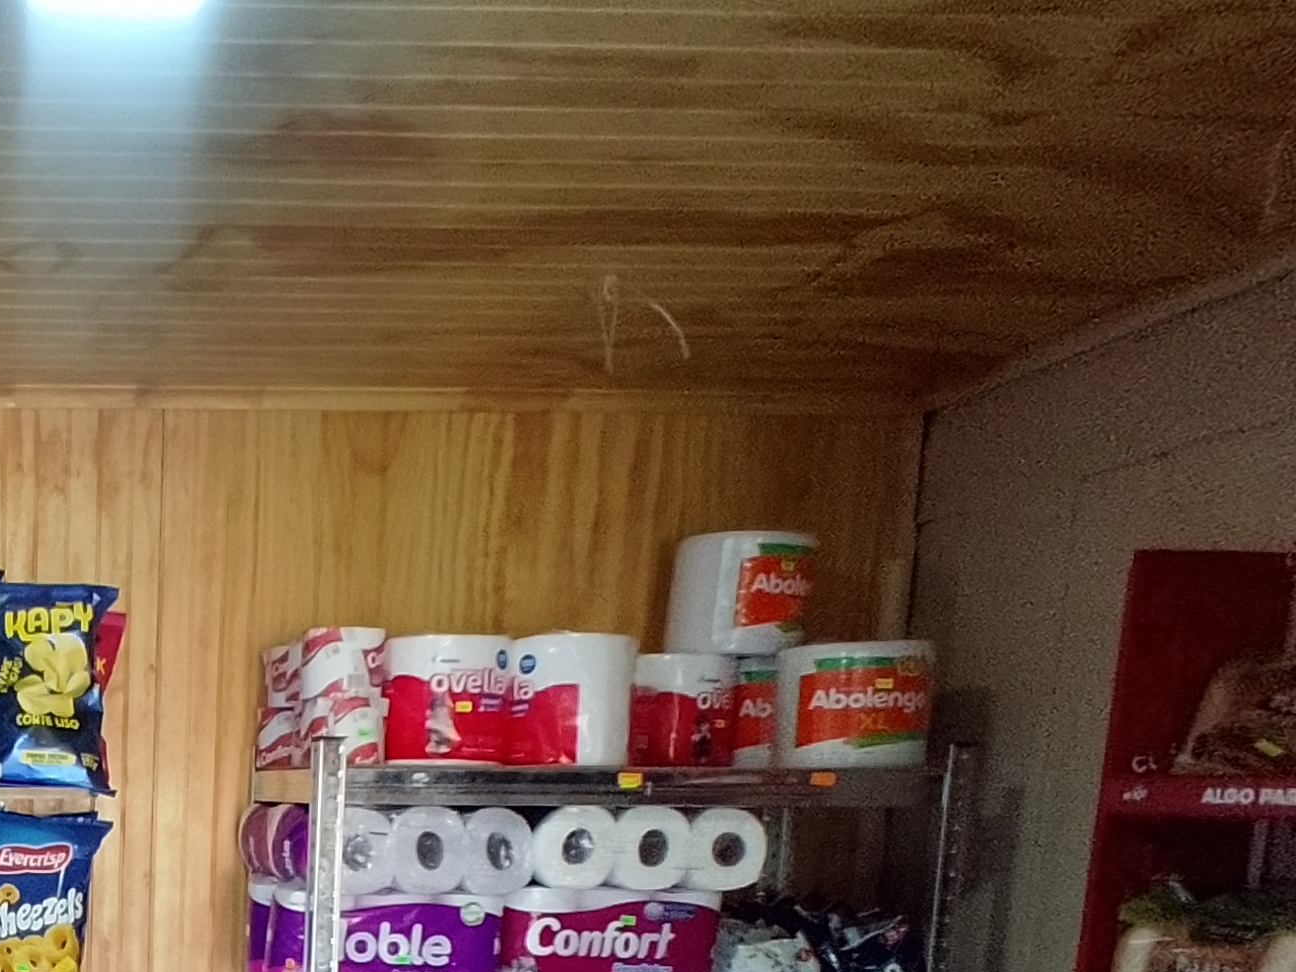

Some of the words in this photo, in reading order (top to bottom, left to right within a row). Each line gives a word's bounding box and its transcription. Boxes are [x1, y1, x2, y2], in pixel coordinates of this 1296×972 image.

[4, 601, 94, 641] KAPY
[1201, 787, 1255, 805] ALGO
[526, 917, 675, 960] Confort
